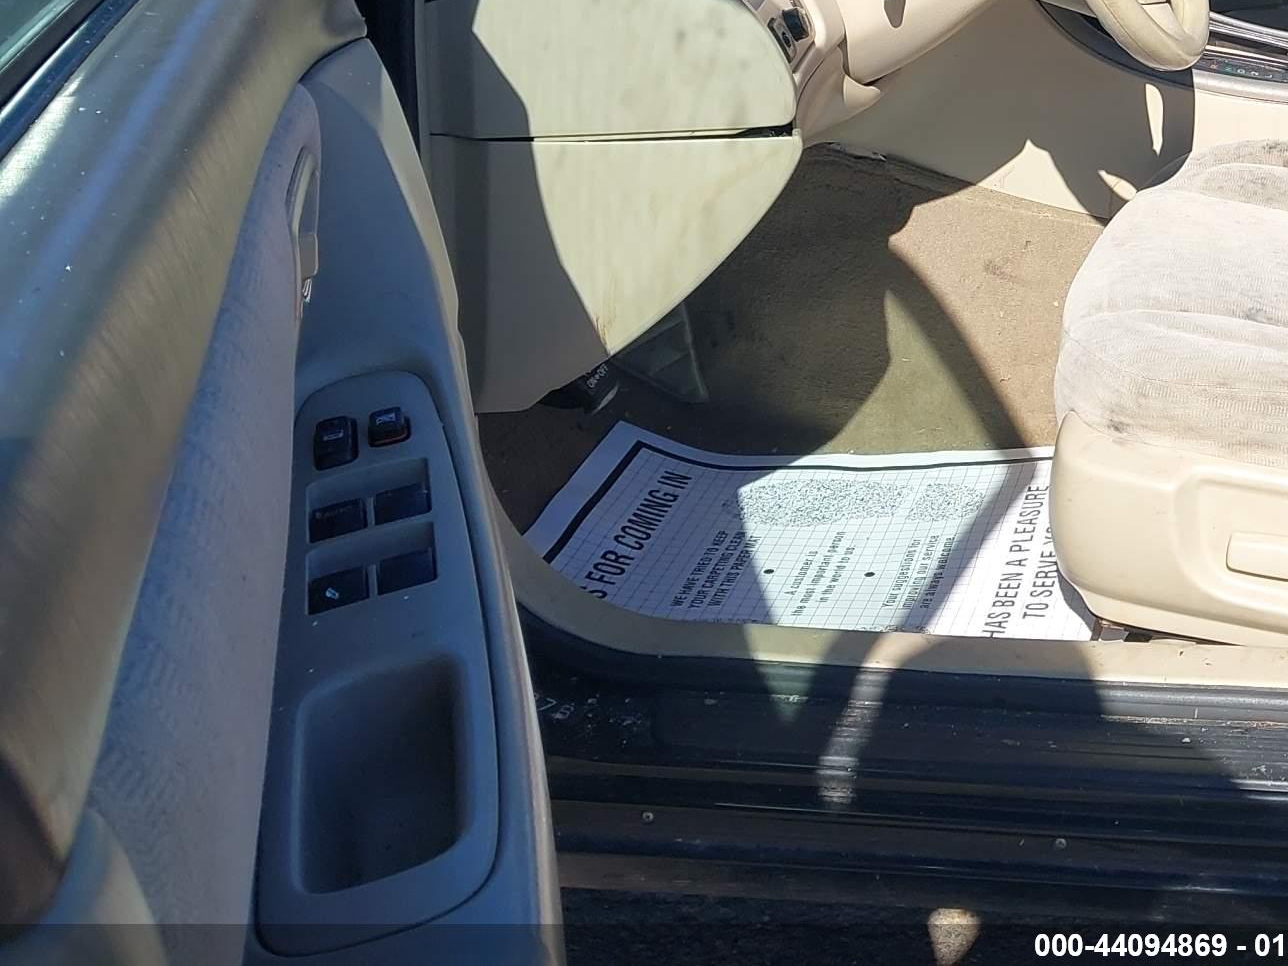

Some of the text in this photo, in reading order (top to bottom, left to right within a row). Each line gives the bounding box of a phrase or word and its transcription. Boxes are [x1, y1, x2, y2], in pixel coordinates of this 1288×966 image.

[585, 549, 635, 585] FOR
[613, 489, 680, 550] COMING
[657, 470, 692, 489] IN
[981, 485, 1049, 638] HAS BEEN A PLEASURE
[670, 531, 728, 607] WE HAVE TRIED TO KEEP
[688, 531, 746, 609] YOUR CARPETING CLEAN
[707, 535, 762, 606] WITH THIS PAPER MAT
[790, 558, 813, 589] customer
[791, 531, 846, 616] the most important person
[820, 584, 836, 594] the
[830, 564, 846, 583] world
[881, 539, 922, 608] Your suggestions for
[898, 535, 939, 610] improving our service
[920, 598, 932, 609] are
[923, 571, 944, 596] always
[1022, 551, 1058, 619] TO SERVE
